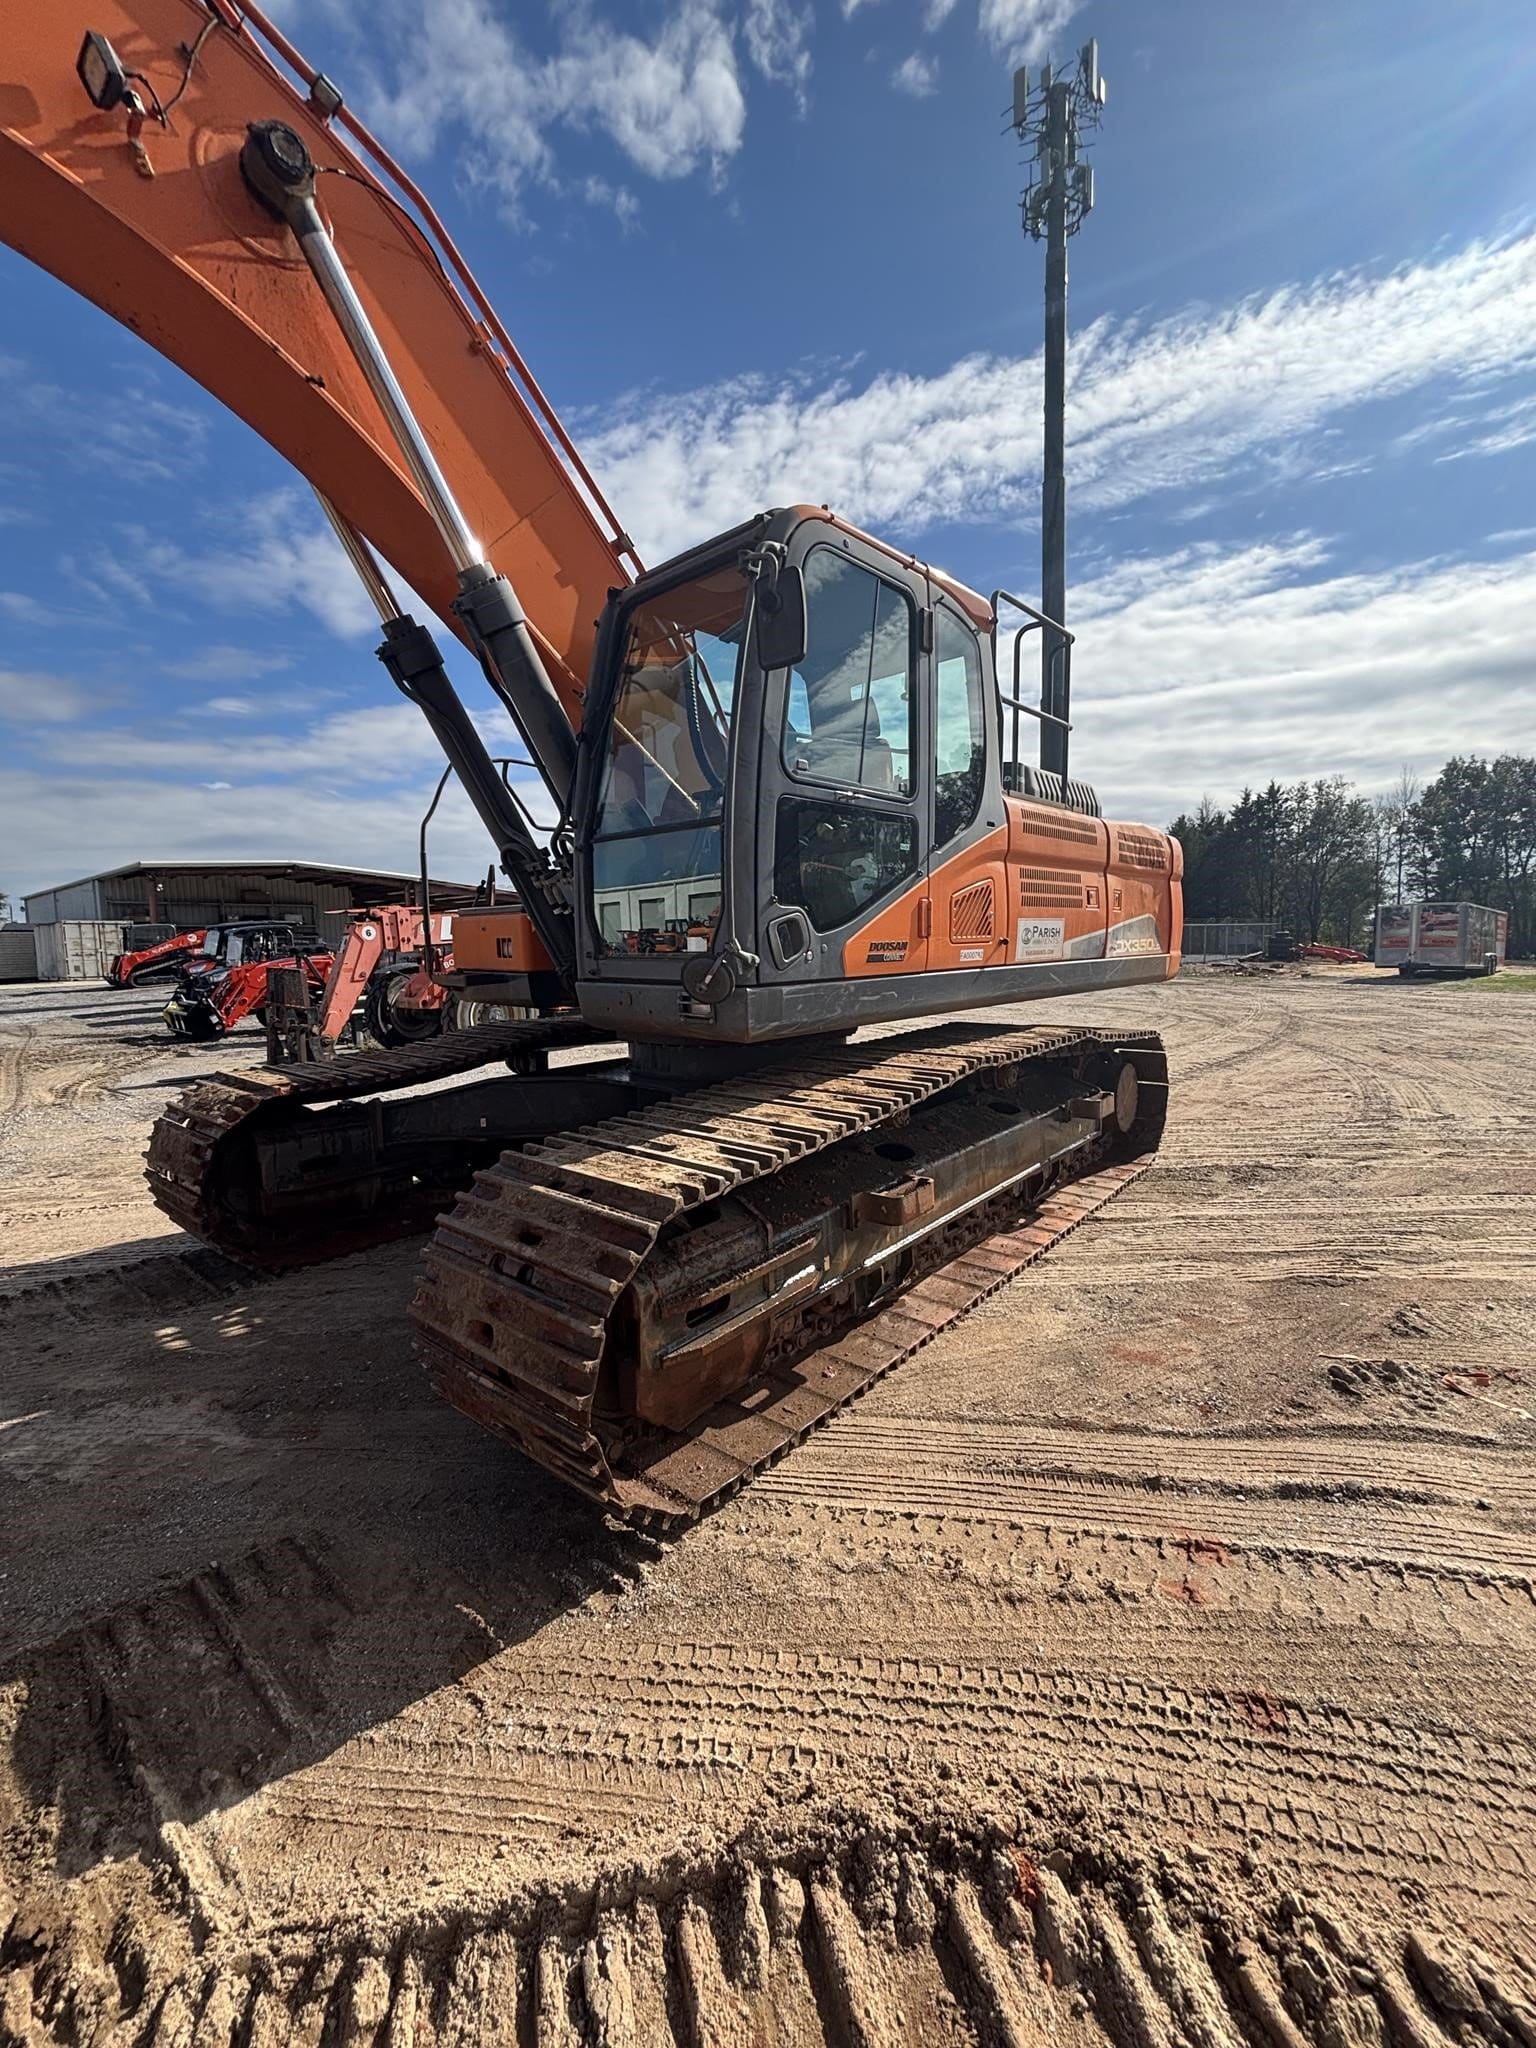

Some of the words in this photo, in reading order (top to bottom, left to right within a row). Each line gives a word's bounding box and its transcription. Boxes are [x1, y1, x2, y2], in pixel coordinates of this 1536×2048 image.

[366, 929, 372, 937] 6
[1032, 925, 1060, 938] PARISH
[869, 942, 908, 952] DOOSAN
